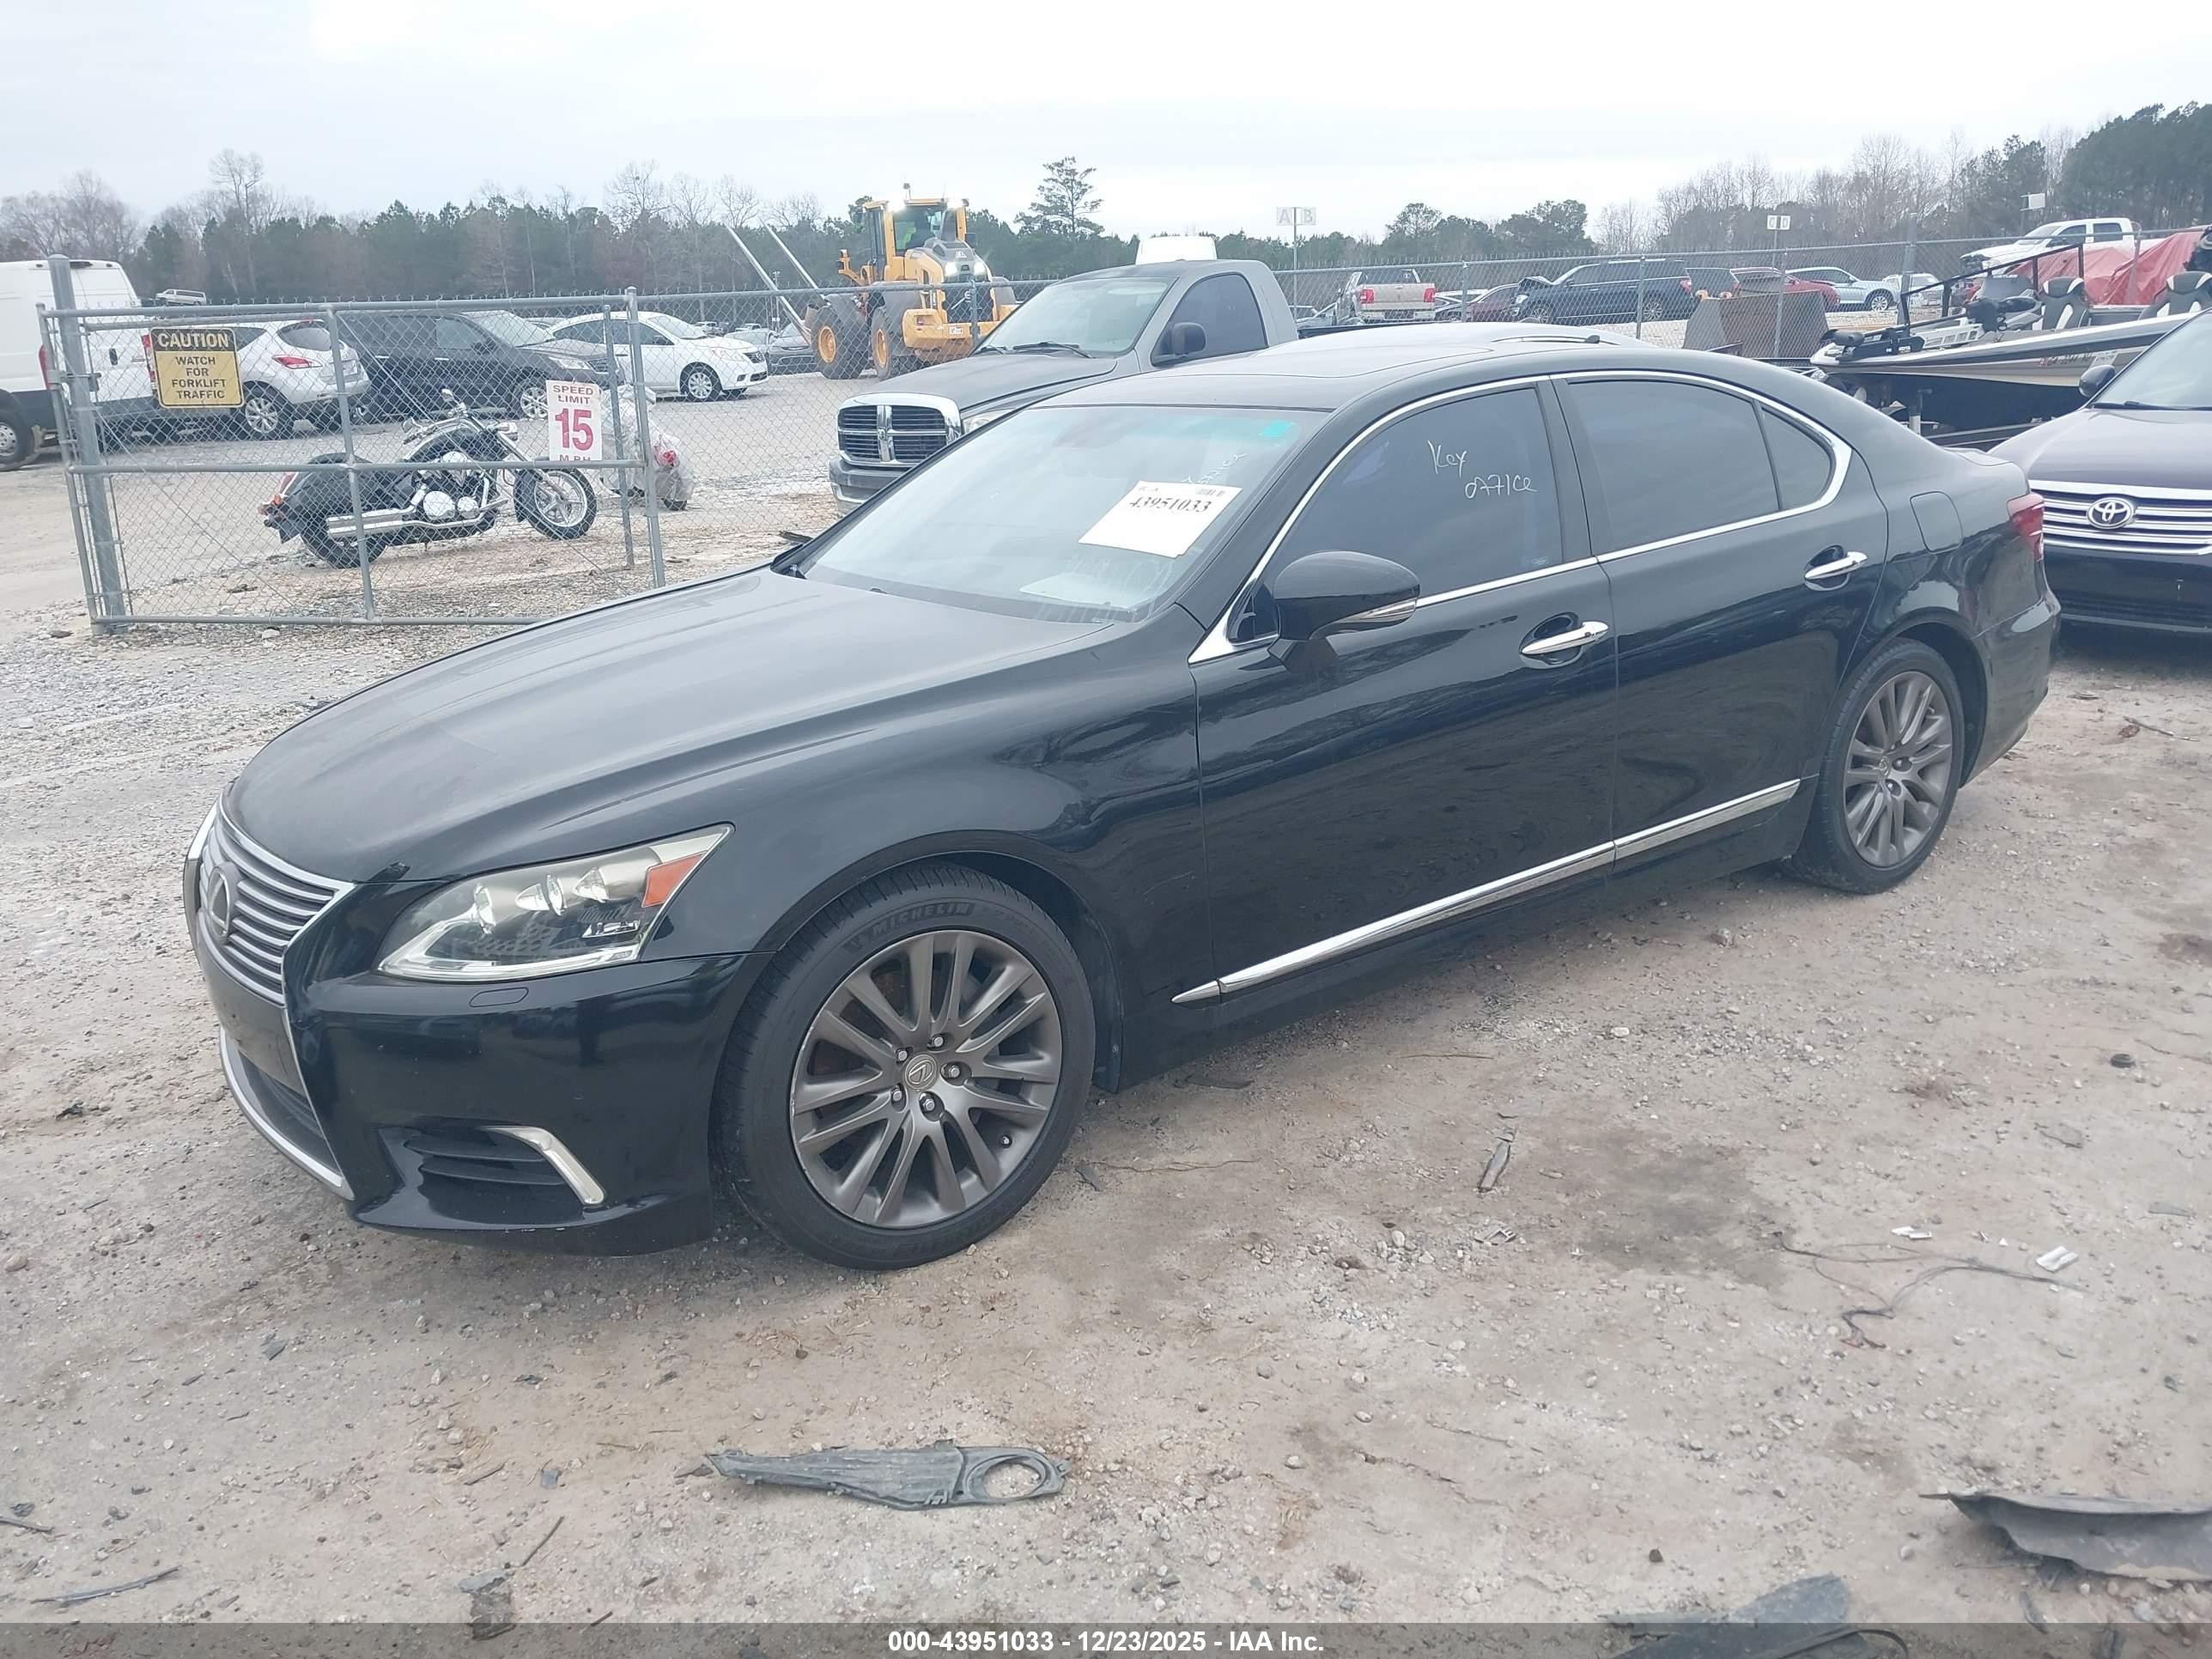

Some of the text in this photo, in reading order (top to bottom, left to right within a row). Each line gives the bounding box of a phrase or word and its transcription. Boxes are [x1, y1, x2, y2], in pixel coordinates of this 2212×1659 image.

[157, 332, 229, 348] CAUTION
[175, 356, 216, 365] WATCH
[185, 368, 209, 376] FOR
[172, 379, 227, 388] FORKLIFT
[177, 390, 225, 399] TRAFFIC
[553, 385, 594, 396] SPEED
[558, 395, 591, 404] LIMIT
[555, 408, 593, 451] 15
[1427, 440, 1468, 478] Key
[1129, 496, 1212, 513] 43951033
[871, 902, 976, 937] MICHELIN
